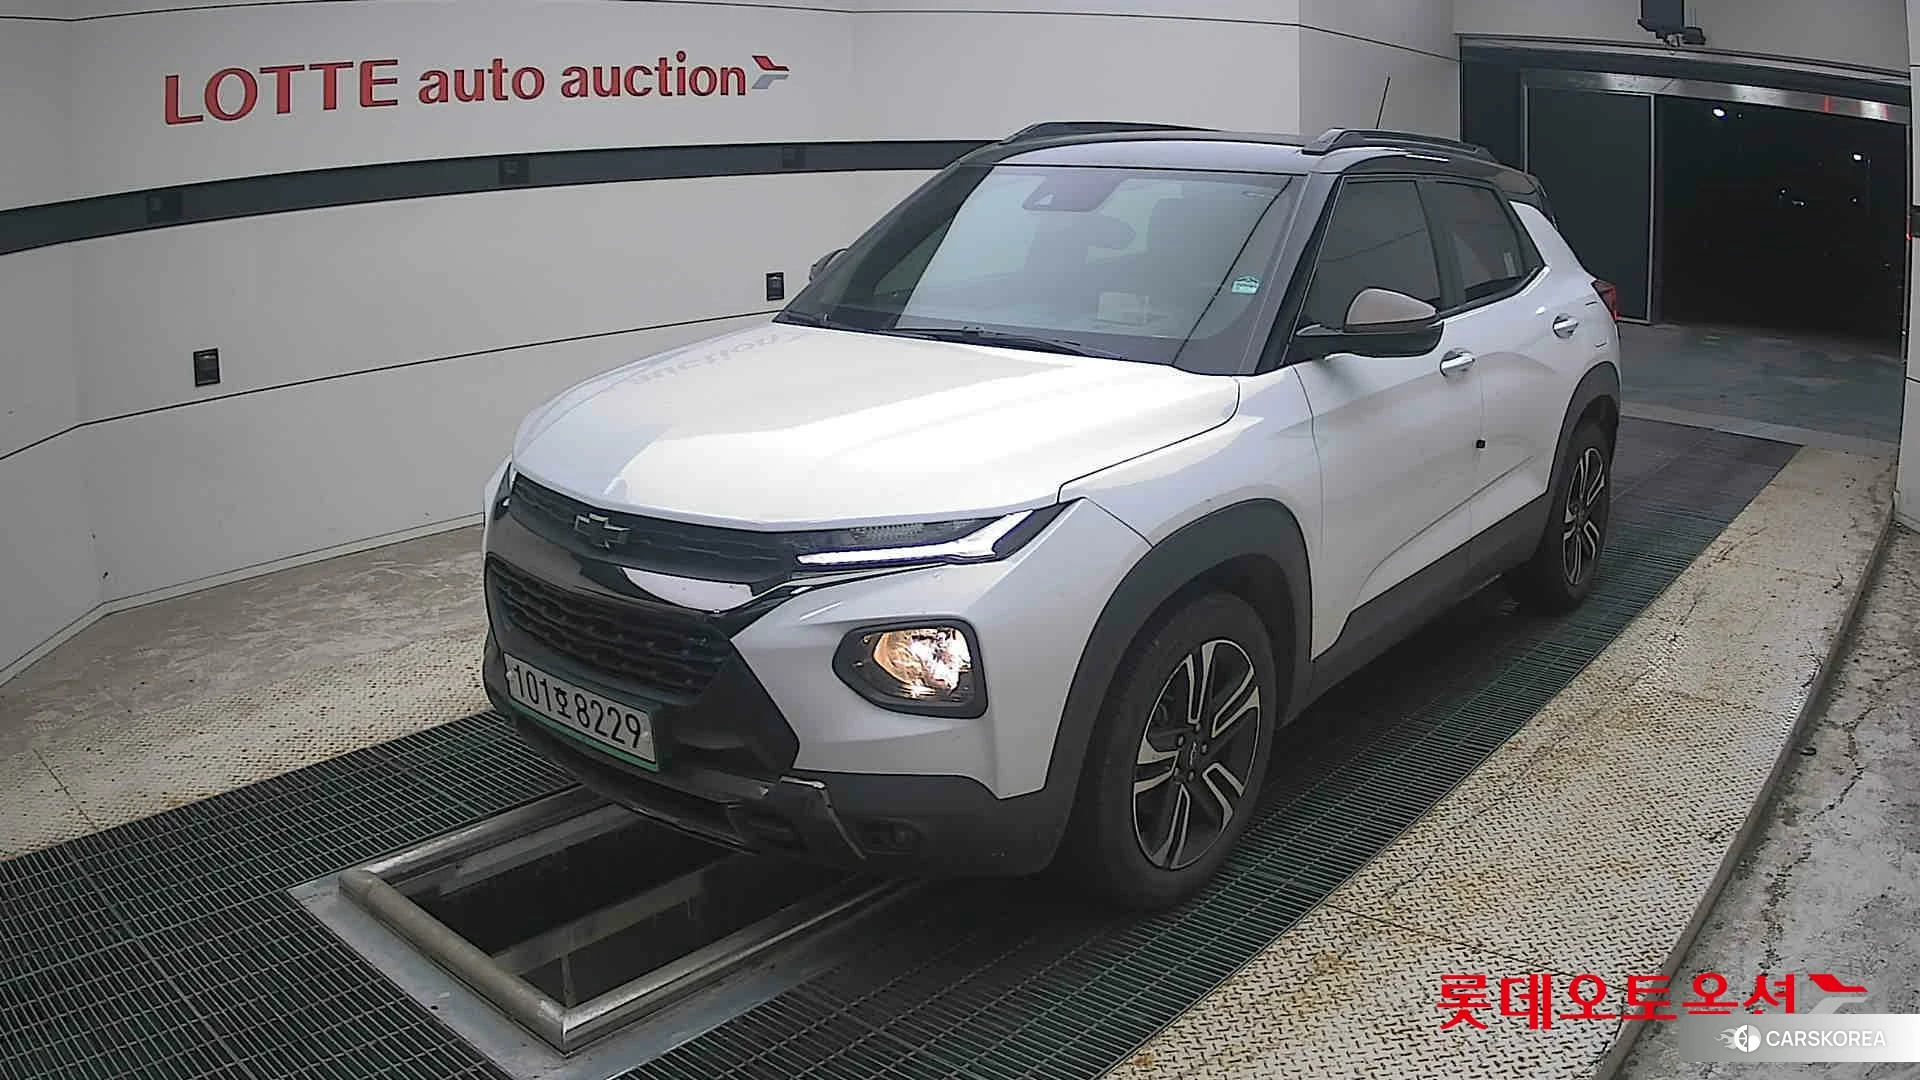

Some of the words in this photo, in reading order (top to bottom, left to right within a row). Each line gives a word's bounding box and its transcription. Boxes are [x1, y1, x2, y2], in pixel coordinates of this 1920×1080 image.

[164, 59, 399, 125] LOTTE
[418, 58, 546, 105] auto
[561, 51, 748, 98] auction
